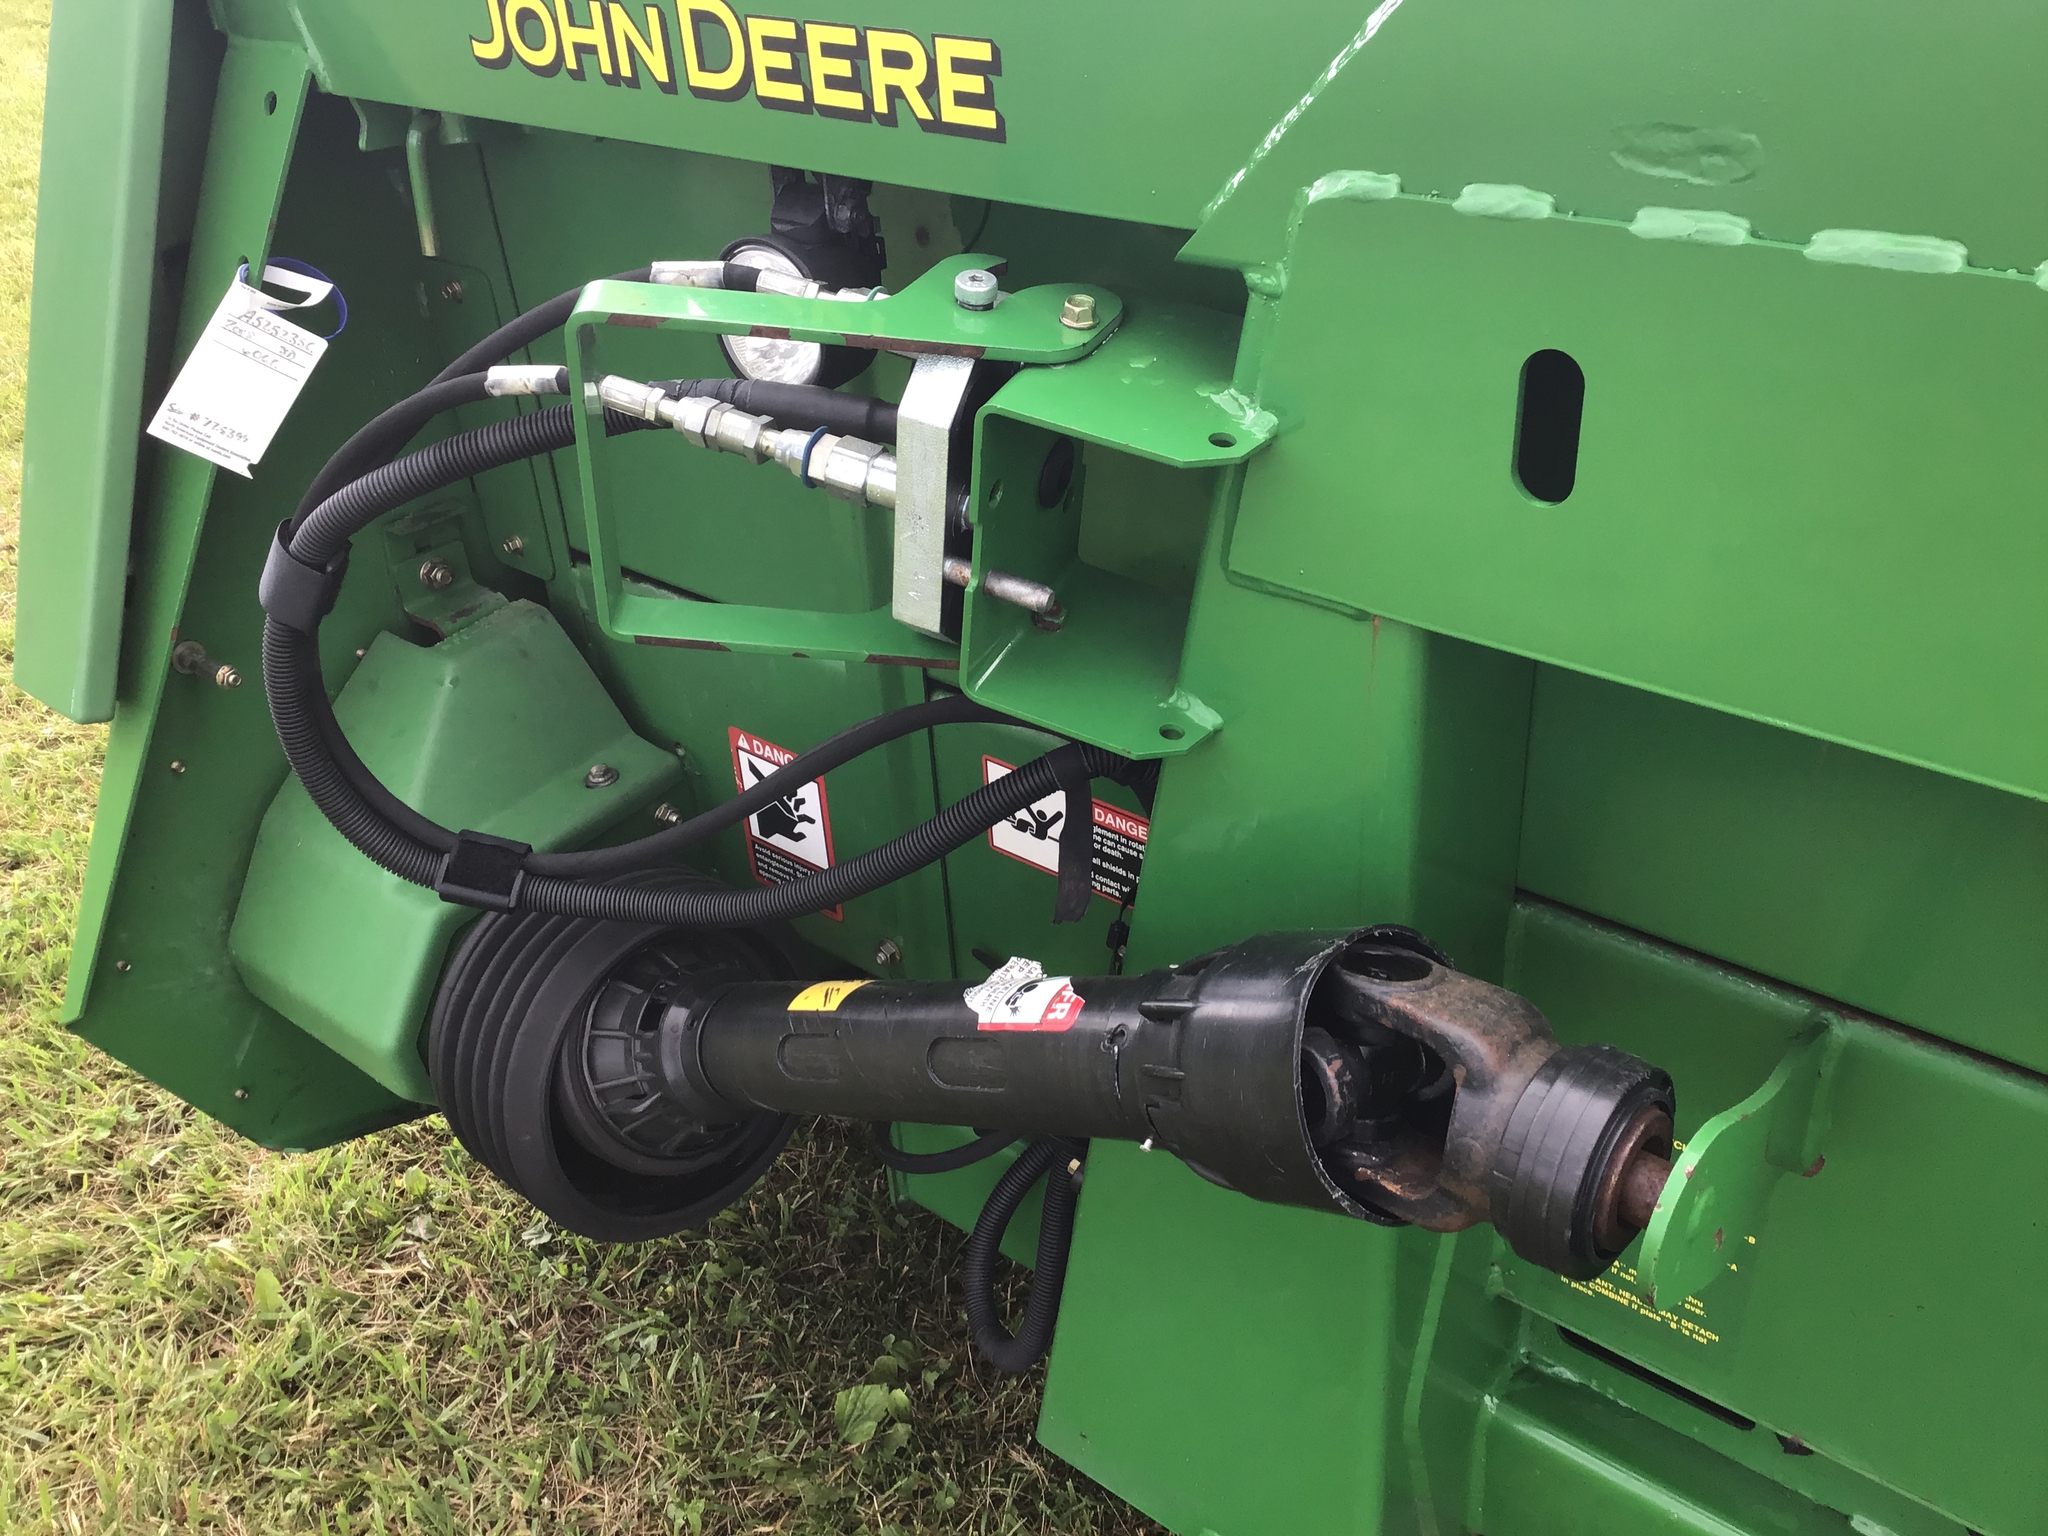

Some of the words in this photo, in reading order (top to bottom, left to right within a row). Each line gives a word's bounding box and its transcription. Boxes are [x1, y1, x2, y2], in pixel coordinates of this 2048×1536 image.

[470, 0, 675, 91] JOHN
[676, 0, 1003, 139] DEERE
[1094, 807, 1148, 841] DANGE
[1093, 825, 1119, 842] lement
[1128, 840, 1146, 853] rotat
[1102, 838, 1116, 848] can
[1116, 843, 1138, 857] cause
[755, 843, 771, 856] Avoid
[771, 852, 793, 867] serious
[793, 862, 810, 876] injury
[1102, 845, 1124, 860] death.
[757, 861, 768, 870] and
[768, 867, 790, 881] remove
[758, 869, 782, 885] opening
[1092, 857, 1101, 866] all
[1101, 861, 1127, 877] shields
[1127, 870, 1135, 880] in
[1095, 874, 1121, 890] contact
[1101, 885, 1122, 898] parts.
[1570, 1281, 1596, 1298] place.
[1588, 1282, 1630, 1306] COMBINE
[1640, 1308, 1662, 1322] plate
[1692, 1333, 1708, 1345] not
[1594, 1277, 1617, 1293] ANT:
[1681, 1318, 1719, 1343] DETACH
[1684, 1303, 1707, 1318] over.
